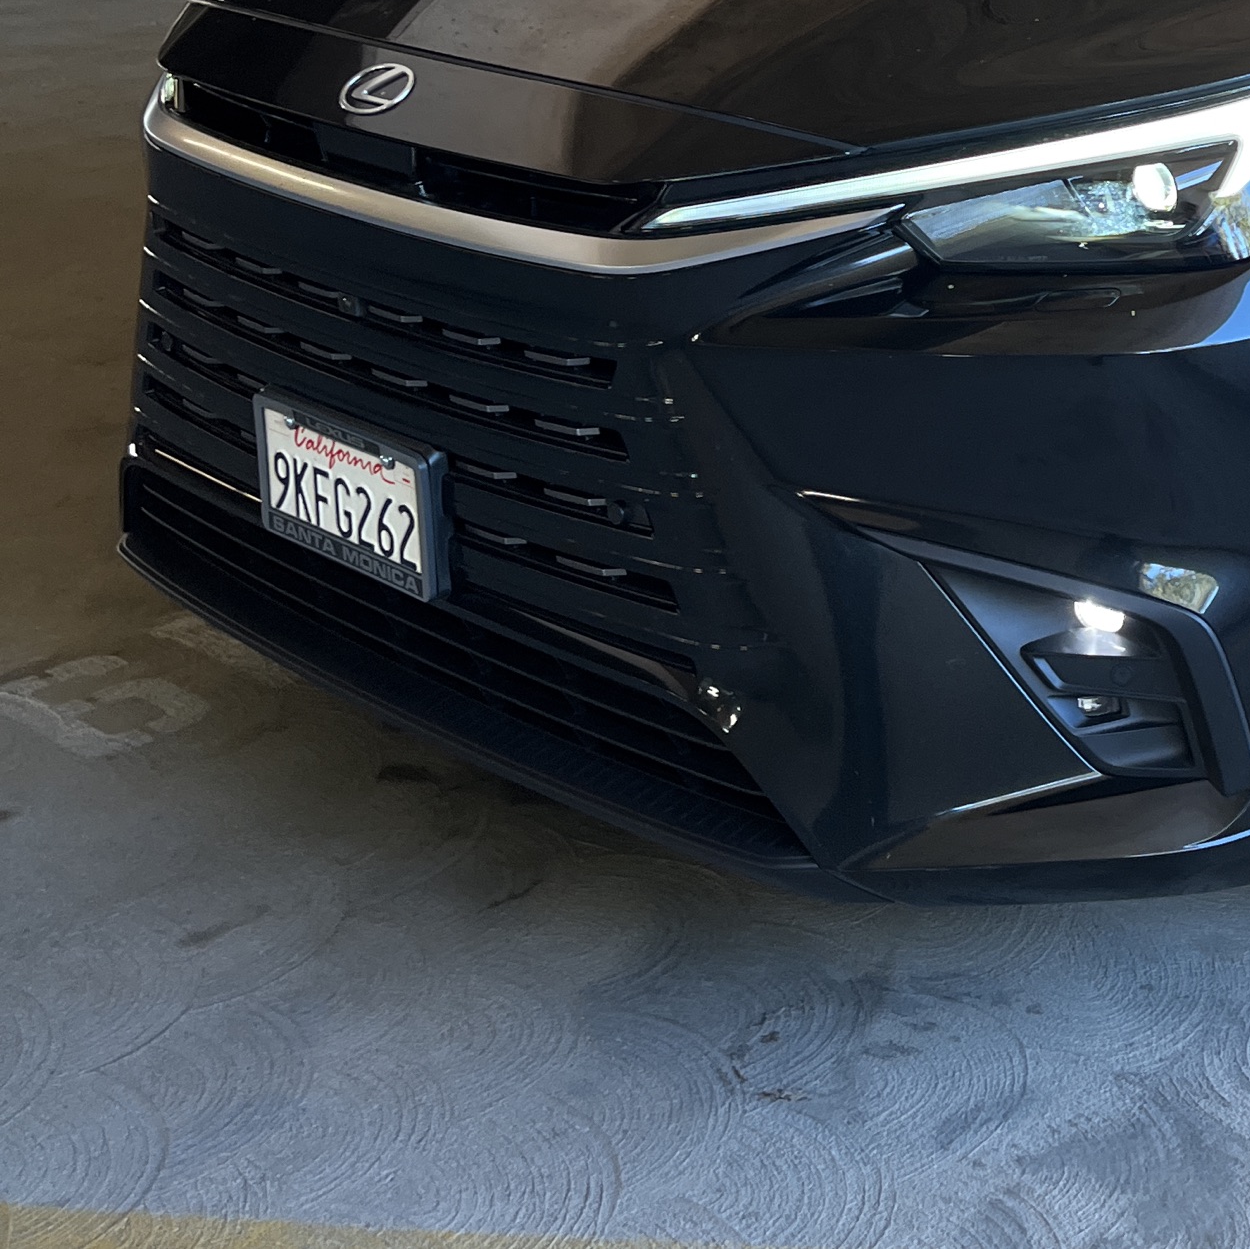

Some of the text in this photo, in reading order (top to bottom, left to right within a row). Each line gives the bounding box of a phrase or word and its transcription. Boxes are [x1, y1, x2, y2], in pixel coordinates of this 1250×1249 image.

[294, 426, 395, 485] California
[306, 418, 365, 449] LEXUS
[273, 451, 418, 572] 9KFG262
[273, 516, 419, 595] SANTA MONICA
